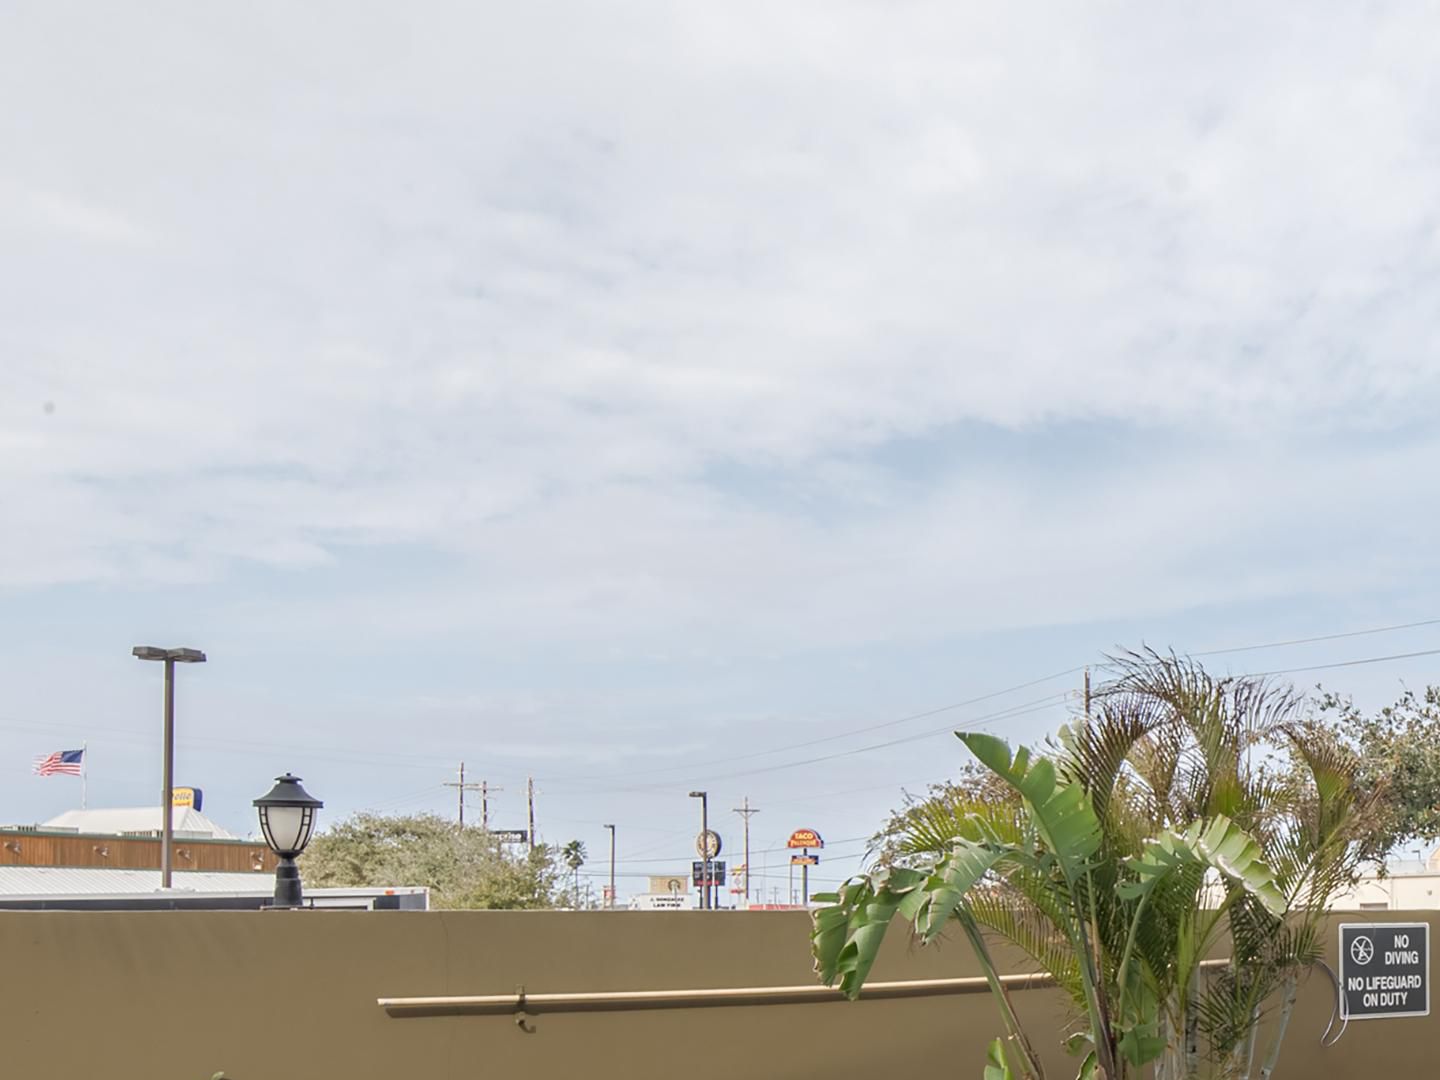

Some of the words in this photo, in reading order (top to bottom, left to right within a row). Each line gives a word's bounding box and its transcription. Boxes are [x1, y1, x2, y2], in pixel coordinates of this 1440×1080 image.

[795, 832, 814, 840] TACO
[1394, 934, 1410, 949] NO
[1384, 950, 1419, 965] DIVING
[1348, 977, 1364, 991] NO
[1366, 975, 1422, 990] LIFEGUARD
[1363, 993, 1378, 1007] ON
[1380, 991, 1408, 1006] DUTY
